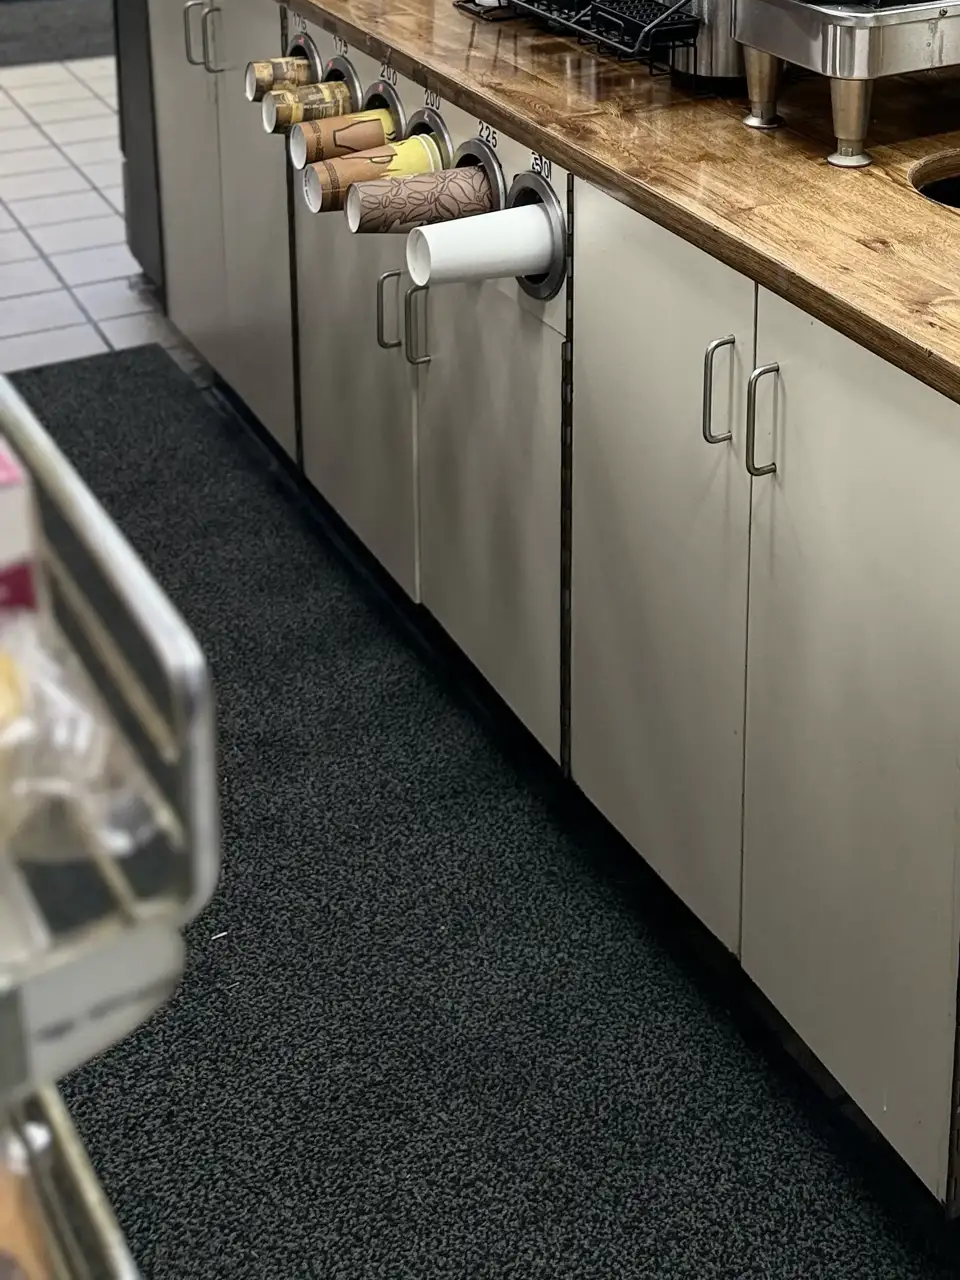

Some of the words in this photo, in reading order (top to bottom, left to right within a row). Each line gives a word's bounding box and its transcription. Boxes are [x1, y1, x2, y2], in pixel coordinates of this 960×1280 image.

[333, 35, 349, 55] 175
[380, 61, 397, 86] 200
[425, 88, 440, 110] 200
[478, 121, 498, 148] 225
